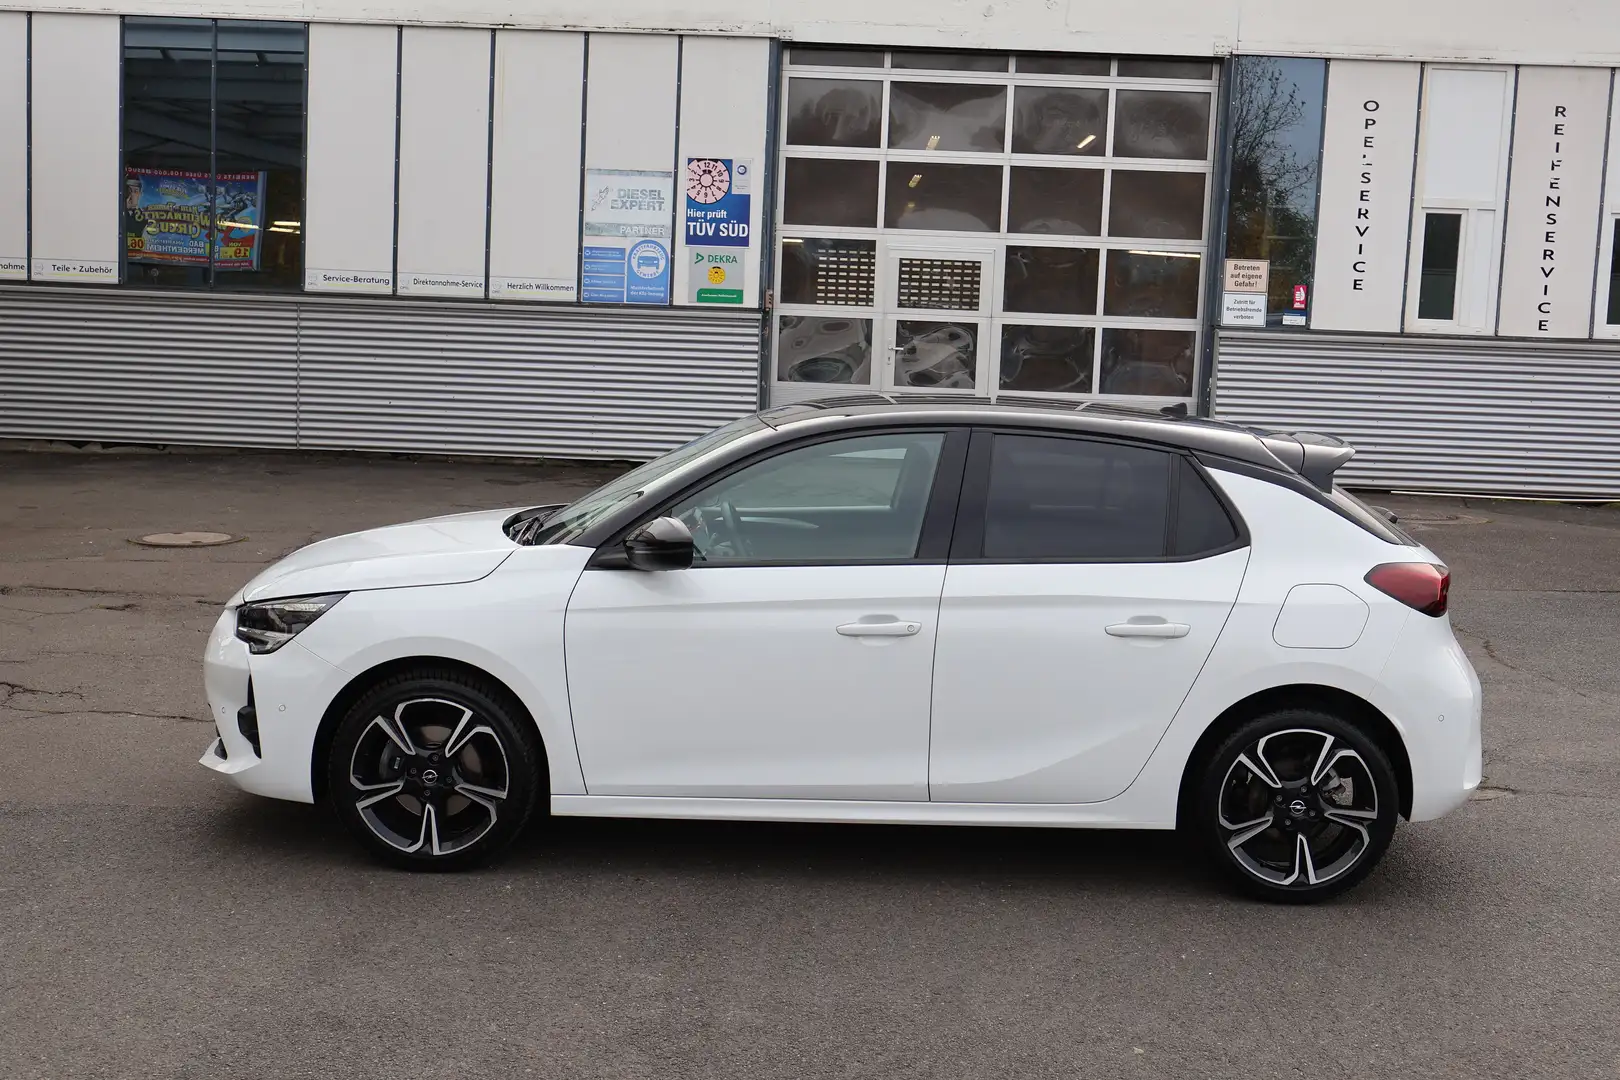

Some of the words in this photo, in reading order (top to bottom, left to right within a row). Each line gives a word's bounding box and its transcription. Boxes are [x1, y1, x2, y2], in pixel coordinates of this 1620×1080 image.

[617, 188, 665, 200] DIESEL
[687, 208, 706, 218] Hier
[707, 209, 728, 220] prüft
[620, 225, 665, 236] PARTNER
[687, 219, 716, 236] TÜV
[719, 220, 749, 237] SÜD
[707, 254, 738, 264] DEKRA
[52, 264, 71, 272] Teile
[79, 265, 112, 274] Zubehör
[1233, 263, 1260, 271] Betreten
[323, 274, 390, 285] Service-Beratung
[413, 278, 483, 288] Direktannahme-Service
[507, 282, 534, 291] Herzlich
[534, 283, 575, 292] Willkommen
